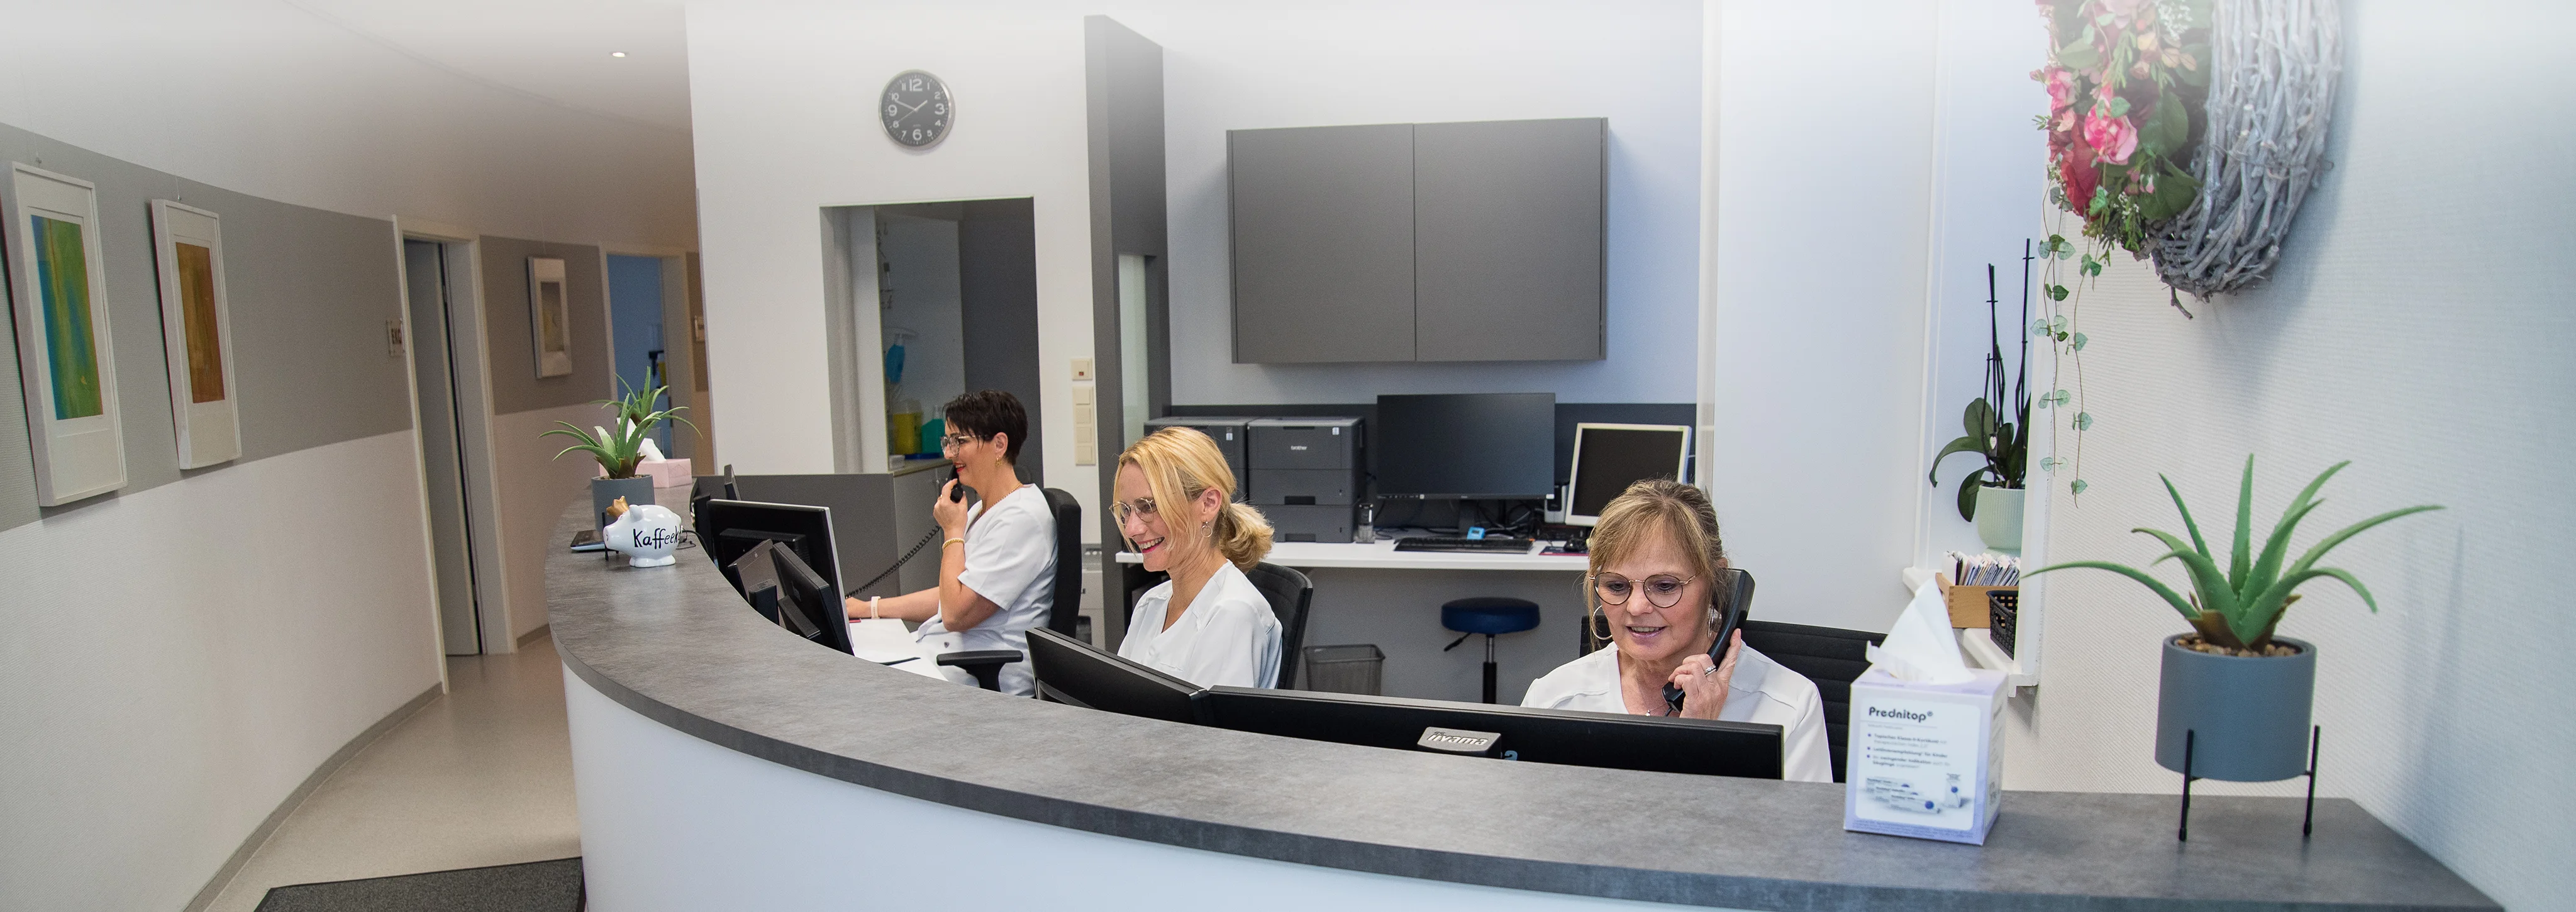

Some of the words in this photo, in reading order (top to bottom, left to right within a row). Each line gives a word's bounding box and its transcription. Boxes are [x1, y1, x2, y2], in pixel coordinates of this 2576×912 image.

[902, 82, 906, 91] 11
[909, 78, 923, 91] 12
[927, 82, 930, 90] 1
[891, 92, 899, 101] 10
[935, 91, 941, 99] 2
[888, 104, 897, 116] 9
[935, 103, 945, 115] 3
[902, 130, 908, 139] 7
[913, 128, 922, 140] 6
[633, 526, 680, 549] Kaffeek
[1427, 731, 1489, 745] iiyama
